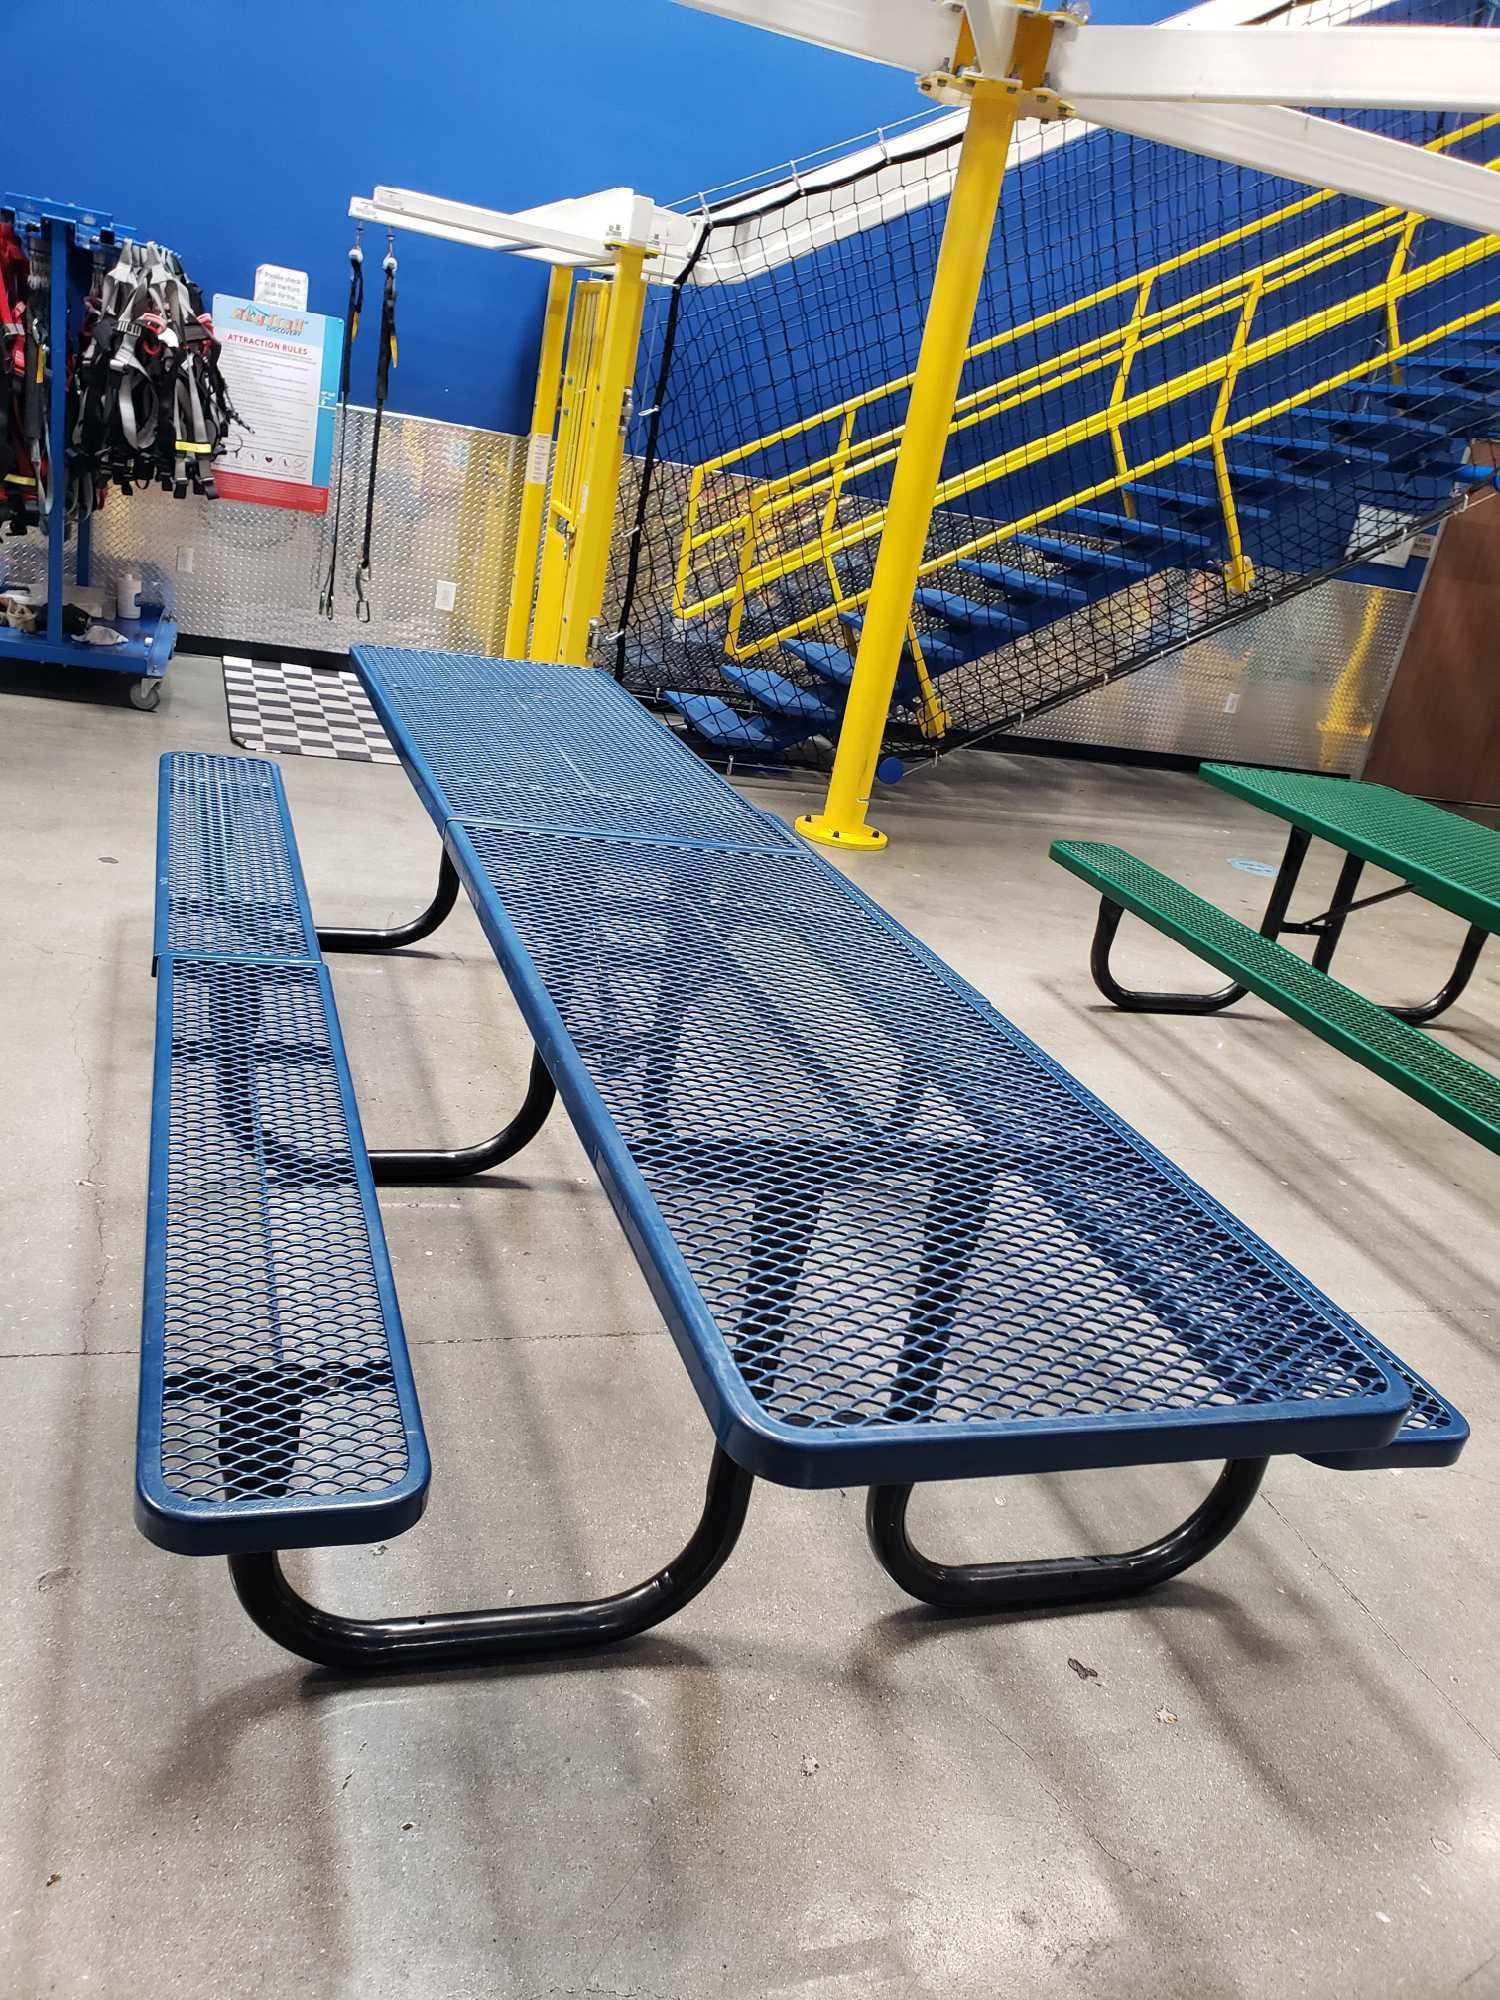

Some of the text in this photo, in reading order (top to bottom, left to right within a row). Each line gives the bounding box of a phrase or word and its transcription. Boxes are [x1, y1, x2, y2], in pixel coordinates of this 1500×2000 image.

[266, 326, 302, 337] DISCOVERY
[227, 334, 308, 355] ATTRACTION RULES
